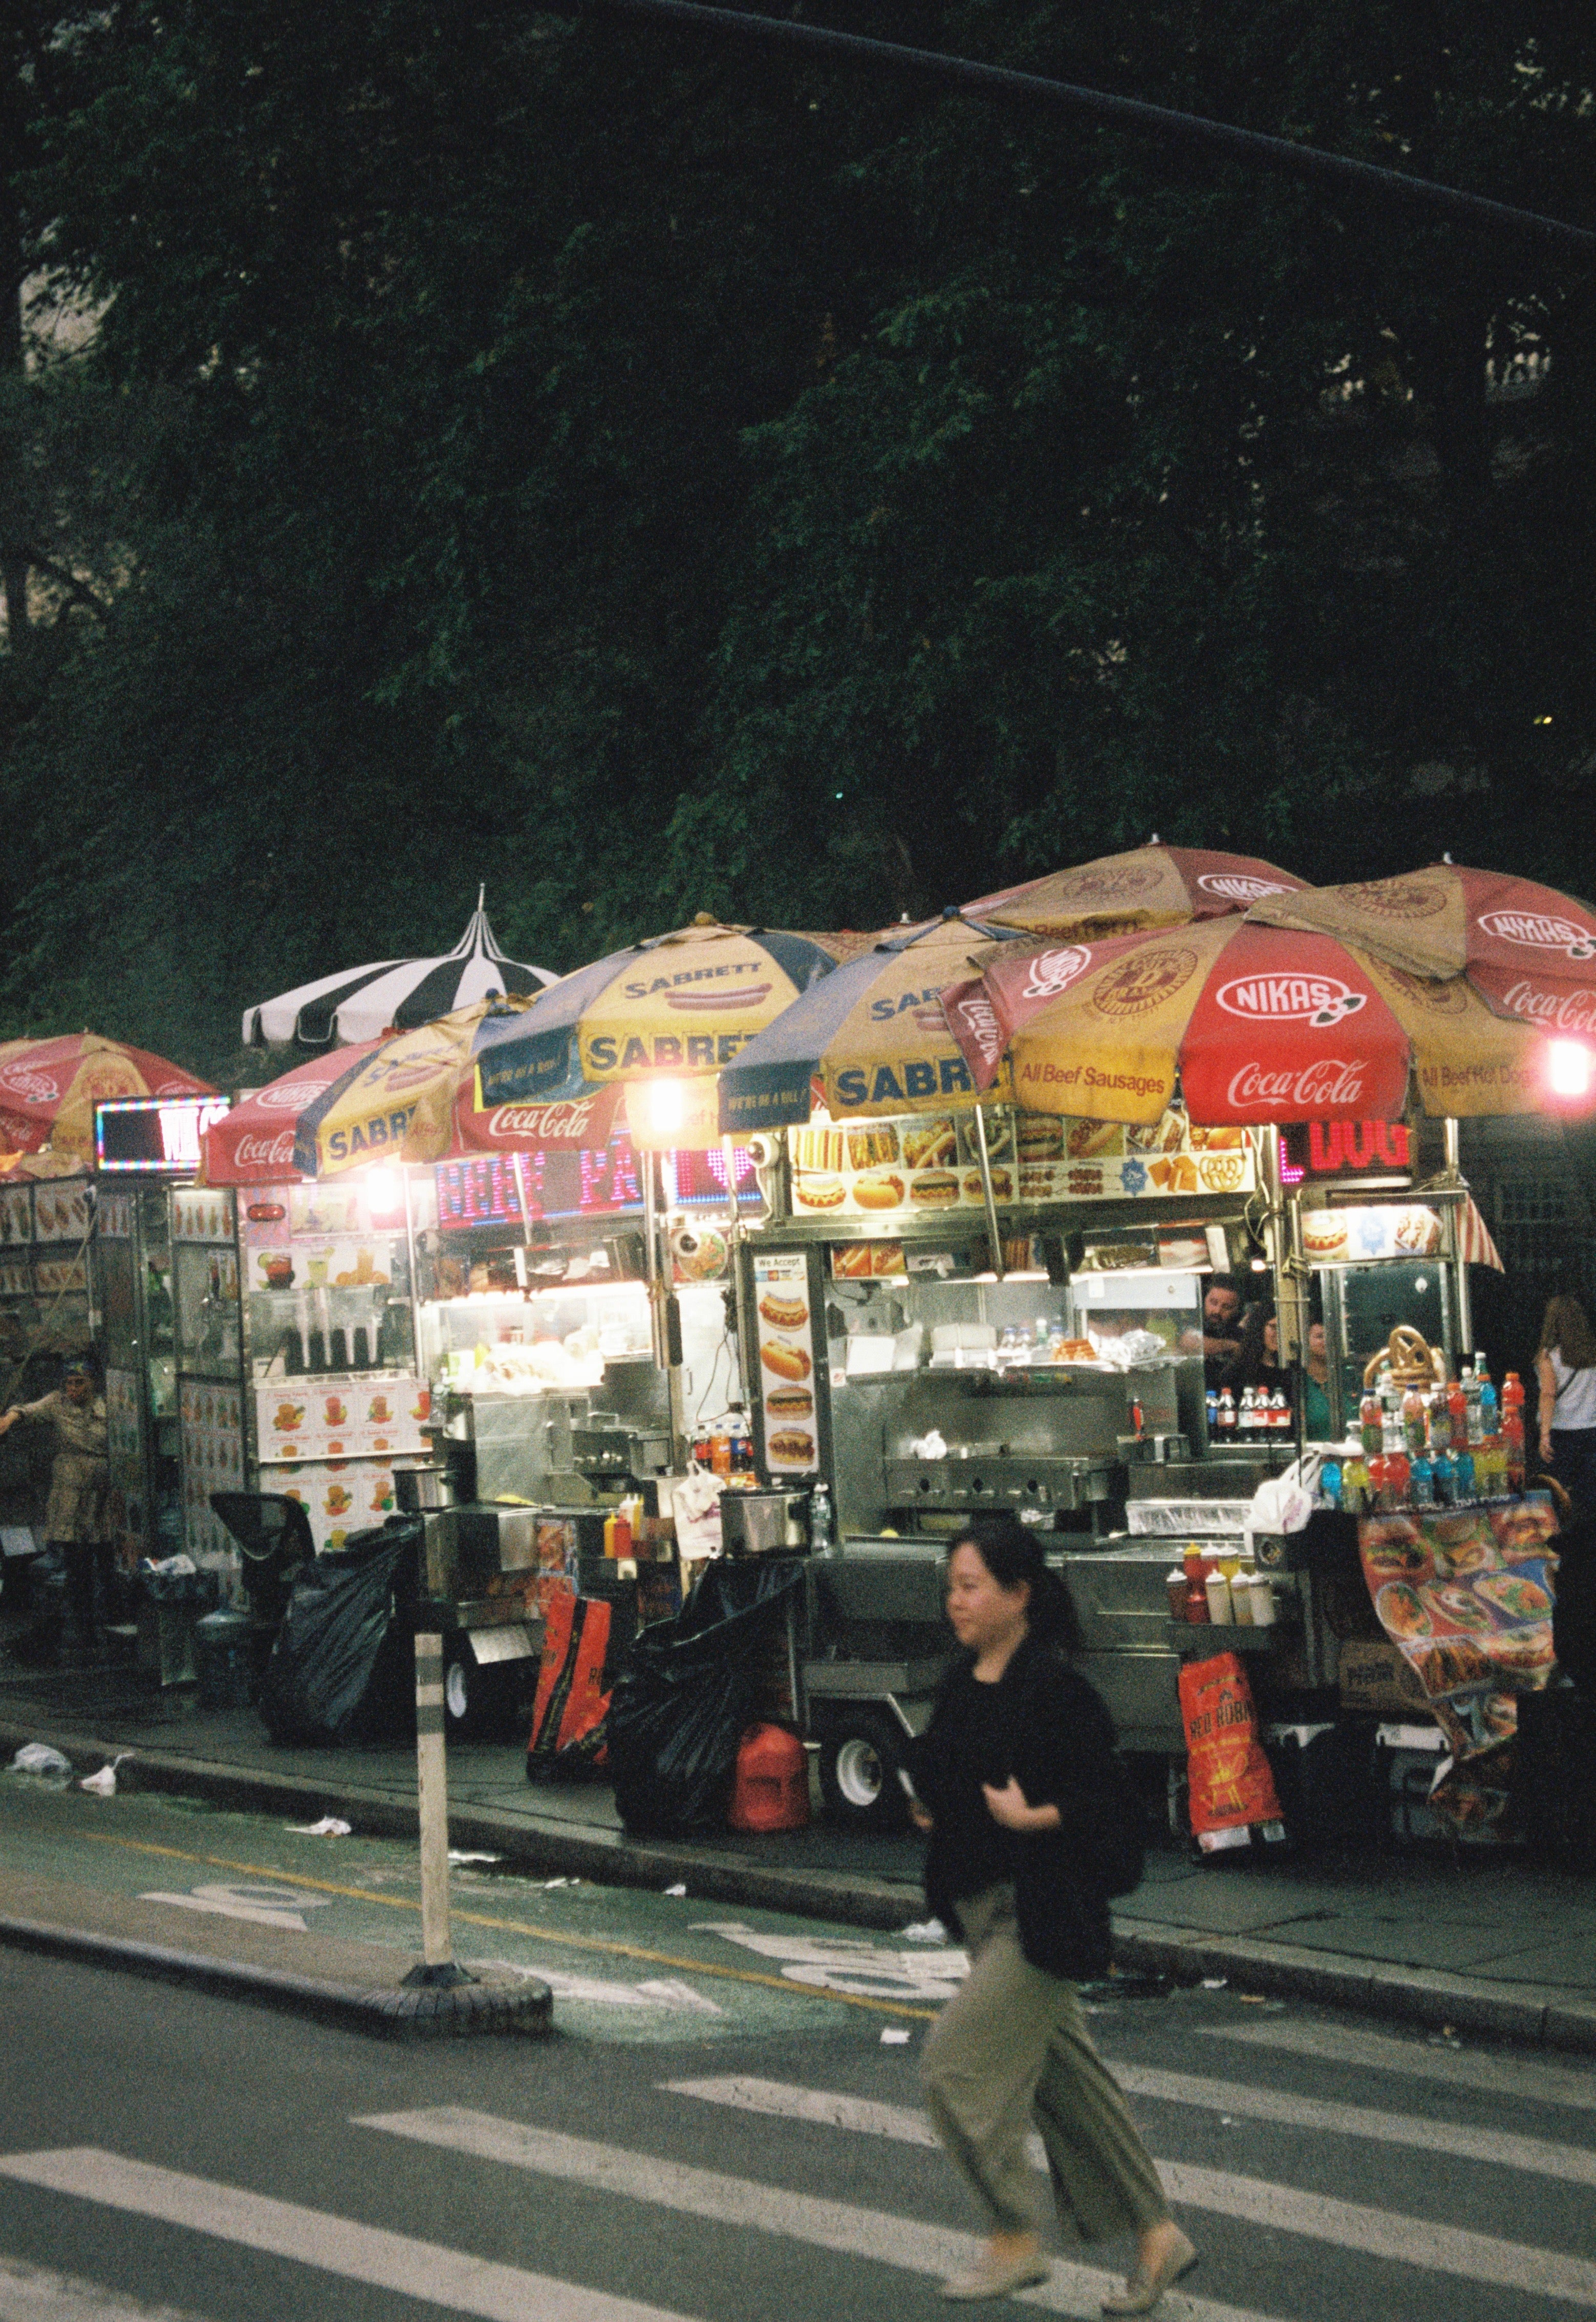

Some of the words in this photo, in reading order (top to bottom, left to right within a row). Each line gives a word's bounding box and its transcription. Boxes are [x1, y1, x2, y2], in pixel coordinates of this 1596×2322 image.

[624, 961, 763, 999] SABRETT
[1236, 979, 1333, 1014] NIKAS
[1503, 980, 1596, 1033] Coca-Col
[589, 1032, 762, 1071] SABRE
[836, 1058, 973, 1106] SABR
[1023, 1063, 1042, 1082] All
[1043, 1064, 1083, 1086] Beef
[1085, 1067, 1165, 1097] Sausages
[1228, 1059, 1370, 1107] Coca-Cola
[328, 1105, 417, 1161] SABR
[488, 1101, 595, 1138] Coca-Cola
[234, 1130, 295, 1168] Coca-Co
